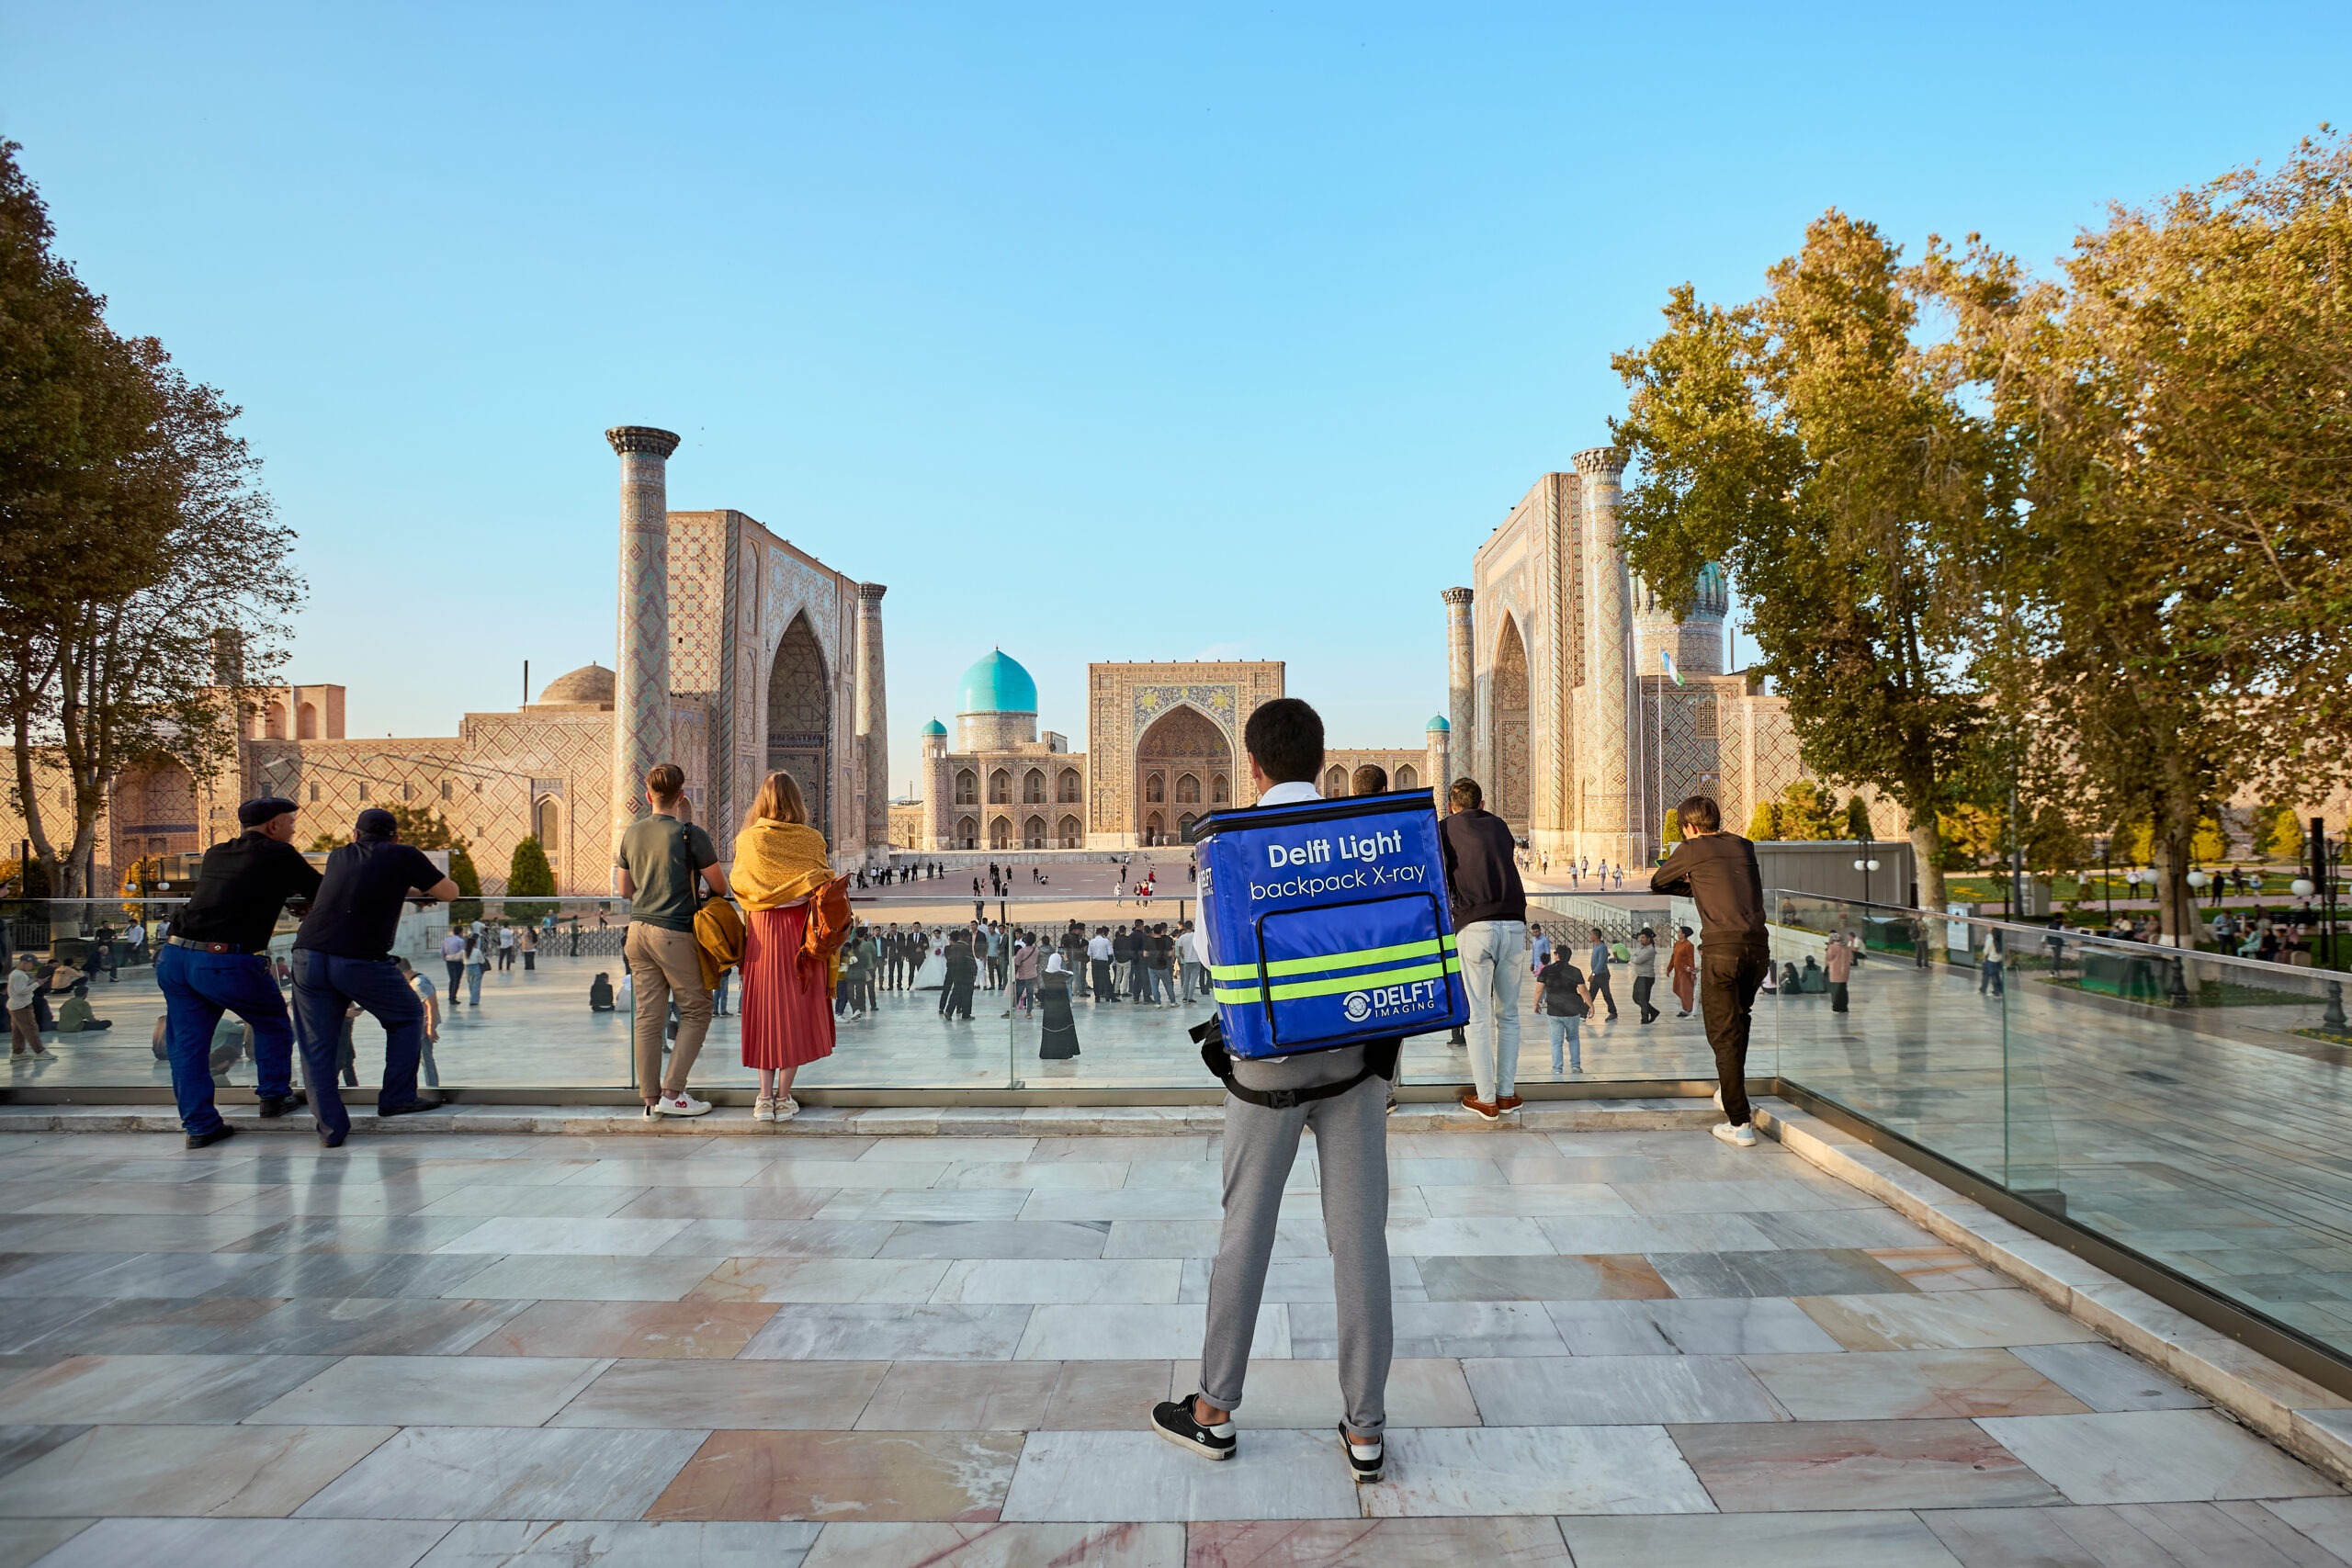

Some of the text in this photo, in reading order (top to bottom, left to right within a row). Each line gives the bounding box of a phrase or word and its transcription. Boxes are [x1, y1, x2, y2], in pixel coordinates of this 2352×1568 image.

[1268, 829, 1402, 868] Delft Light
[1250, 864, 1426, 900] backpack X-ray
[1373, 979, 1435, 1009] DELFT
[1374, 999, 1435, 1018] IMAGING
